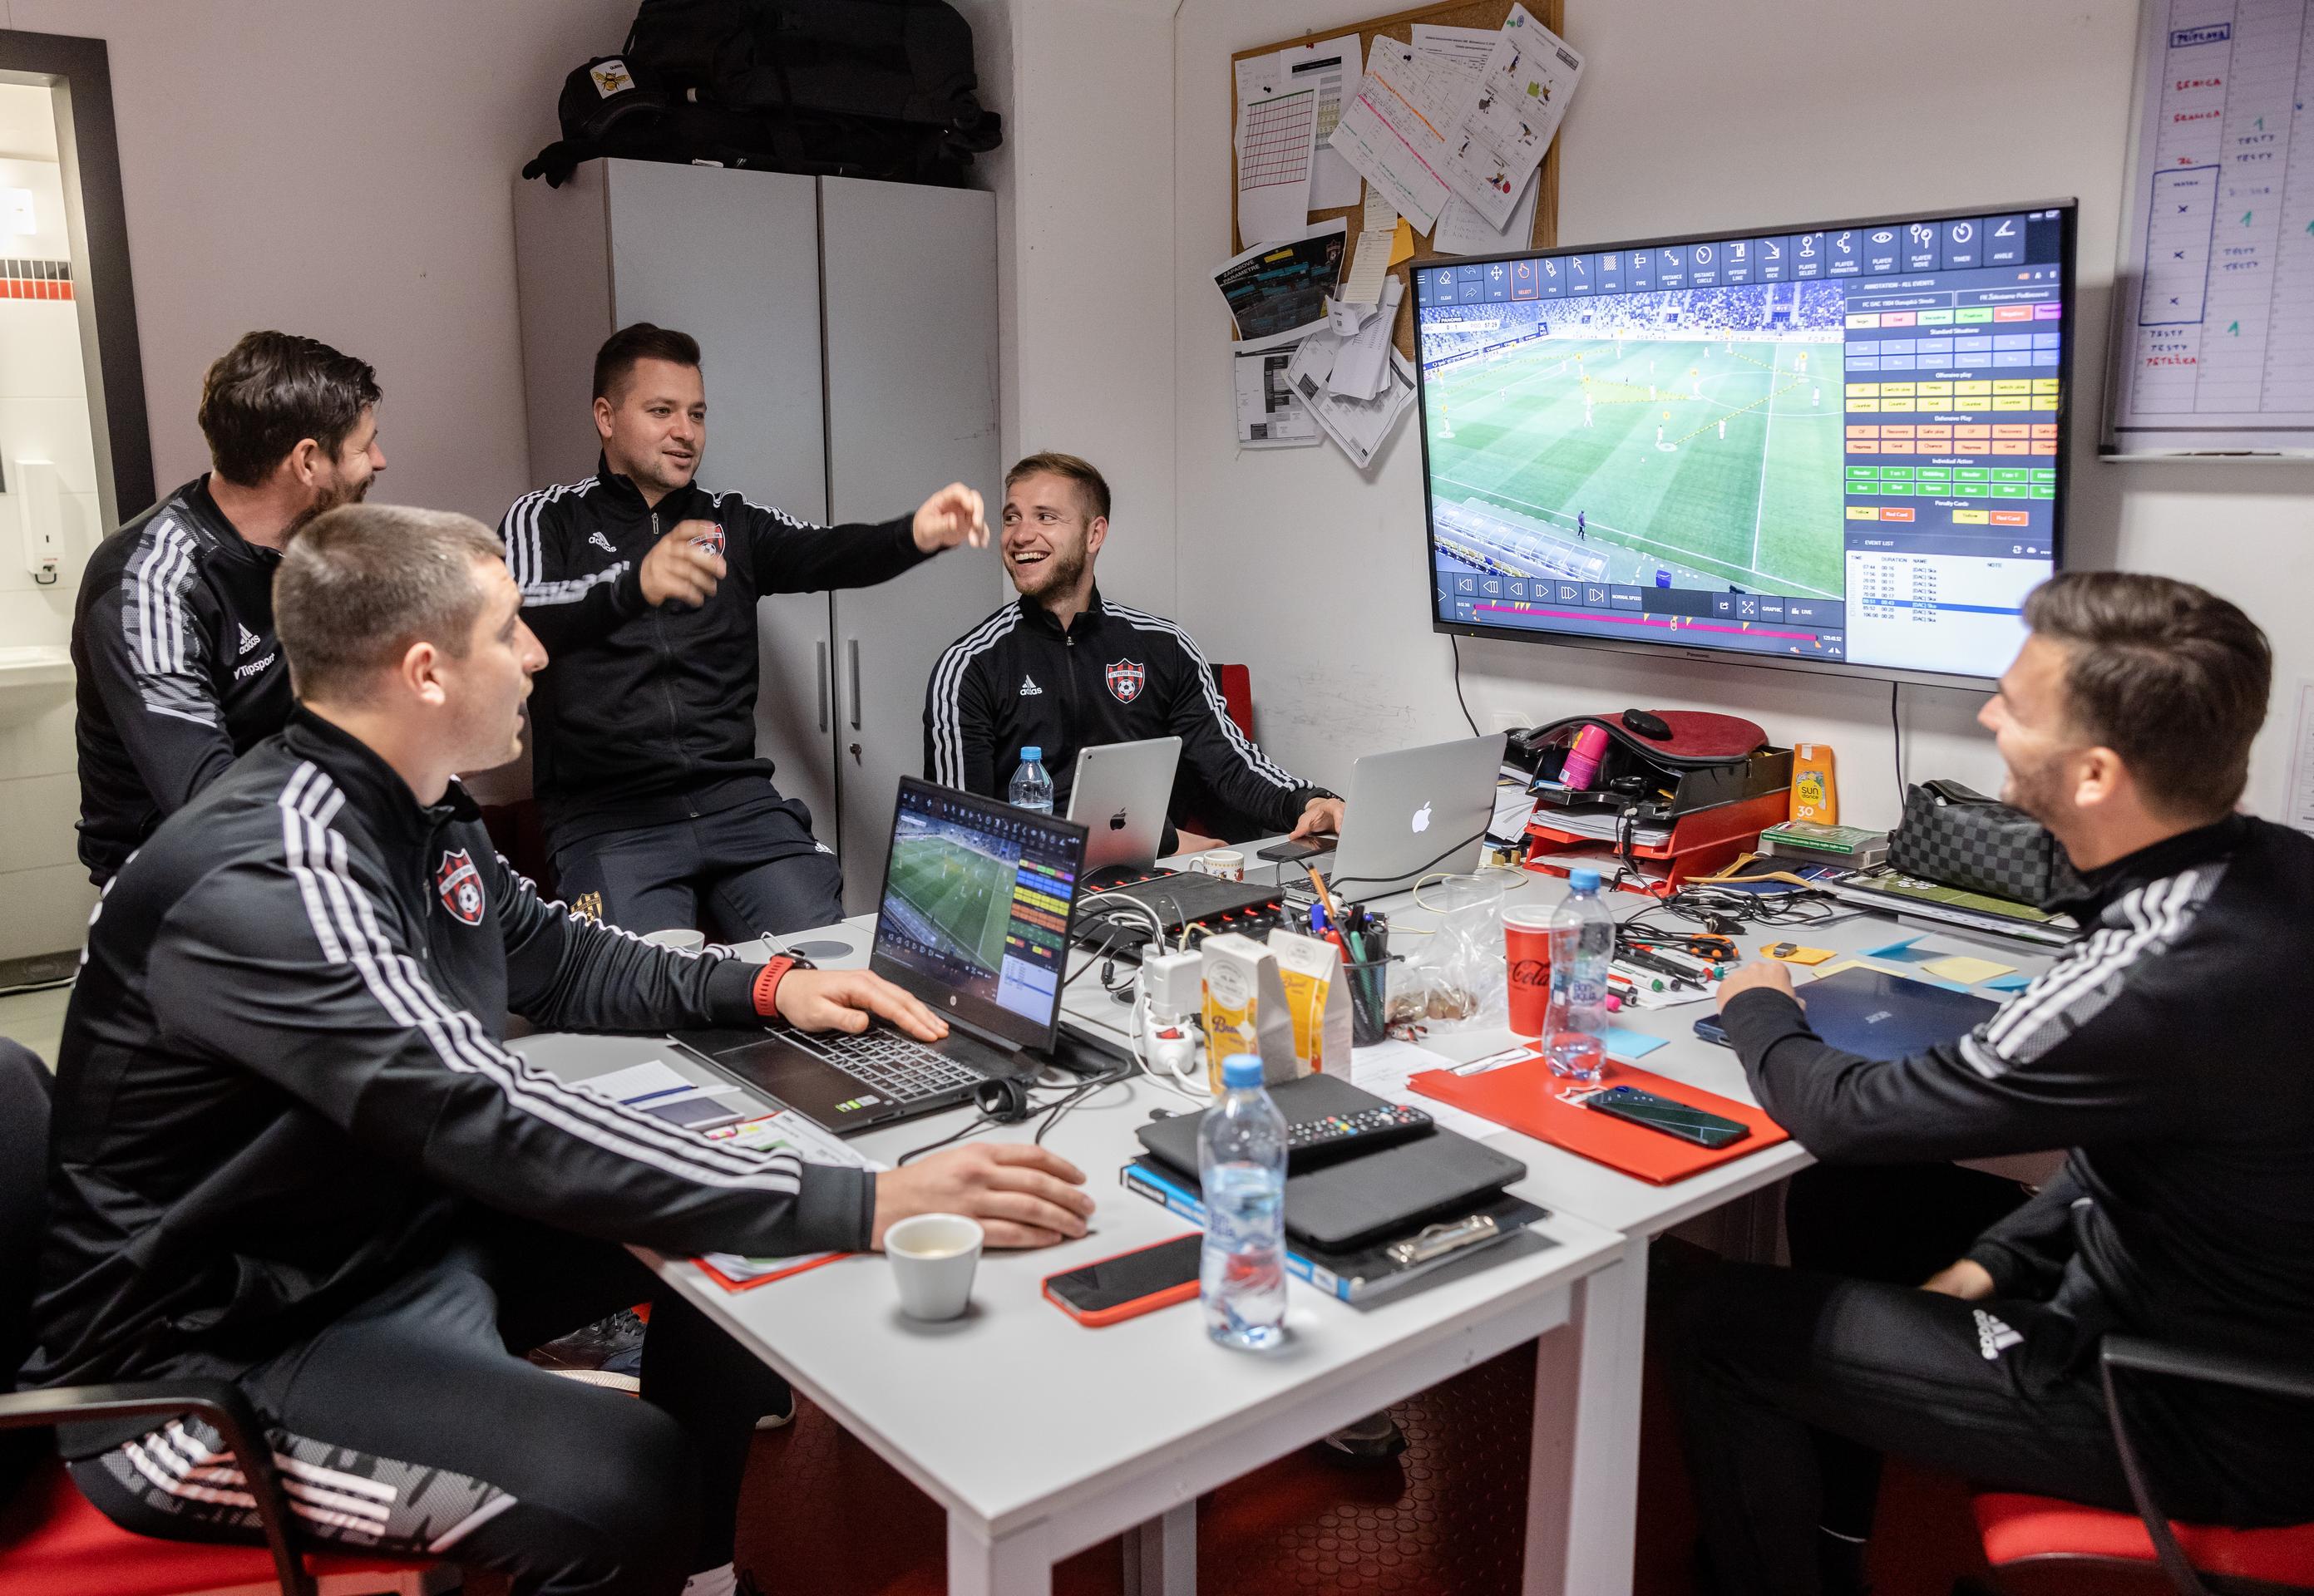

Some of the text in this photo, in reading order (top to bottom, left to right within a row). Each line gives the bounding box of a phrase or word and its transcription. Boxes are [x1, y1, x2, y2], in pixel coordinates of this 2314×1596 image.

[1872, 257, 1893, 265] PLAYER
[1993, 252, 2014, 260] ANGLE
[1874, 263, 1891, 271] SIGHT
[1863, 281, 1898, 290] ANNOTATION
[1912, 278, 1935, 287] EVENTS
[1960, 372, 1972, 380] play
[588, 536, 617, 553] adidas
[239, 634, 261, 655] adidas
[240, 653, 275, 676] Tipsport
[1019, 687, 1043, 696] adidas
[1801, 785, 1819, 796] sun
[1797, 805, 1813, 817] 30
